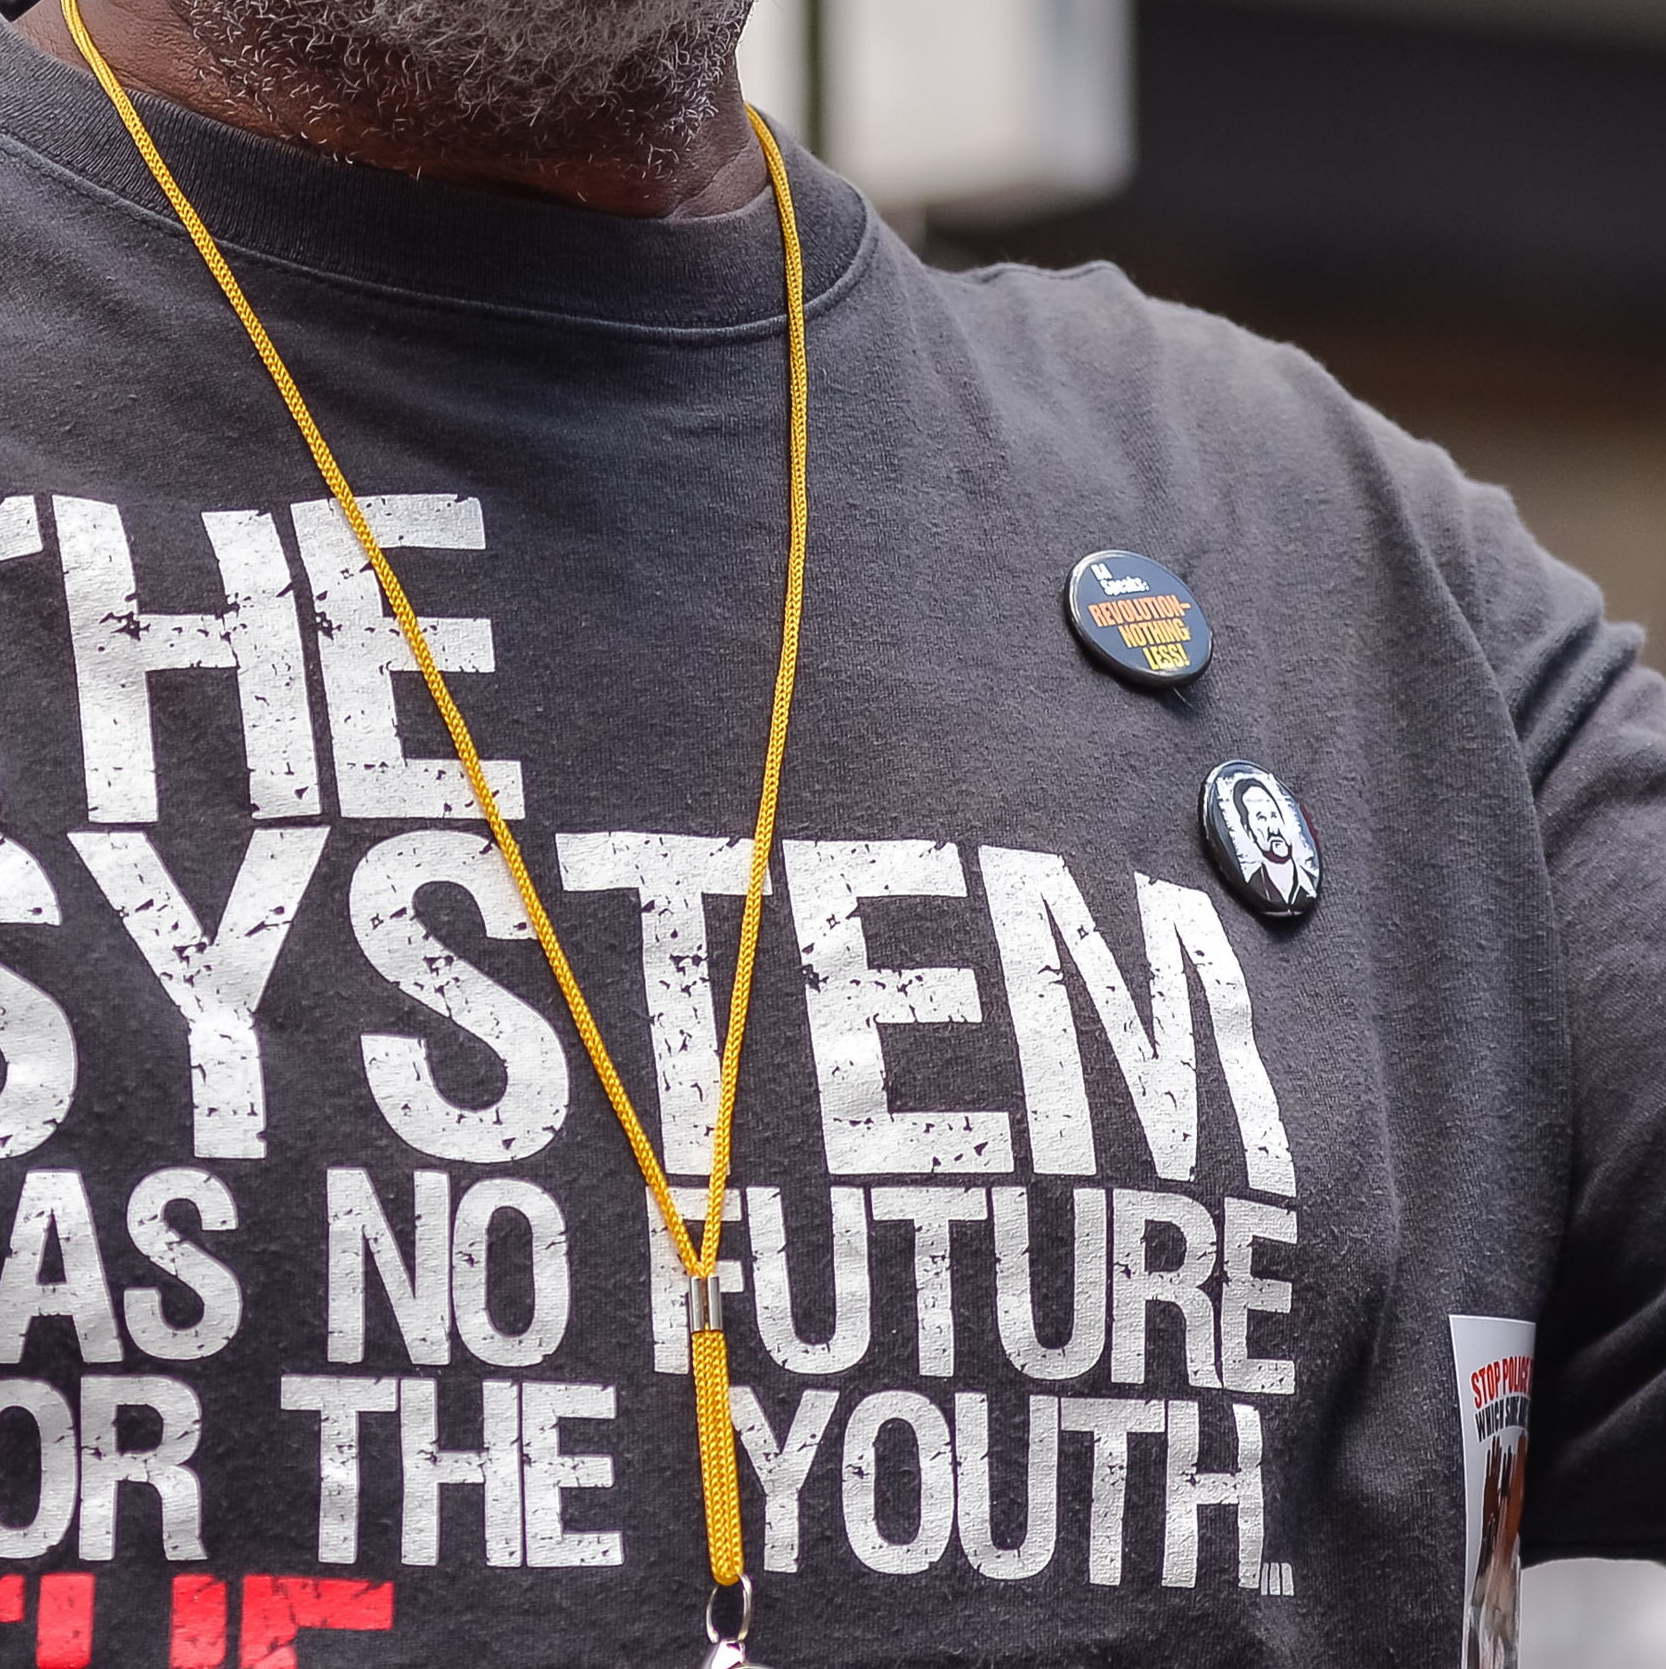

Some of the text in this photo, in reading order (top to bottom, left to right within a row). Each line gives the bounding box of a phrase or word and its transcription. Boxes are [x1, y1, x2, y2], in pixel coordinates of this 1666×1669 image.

[1118, 618, 1191, 649] NOTHING
[1143, 643, 1190, 670] LESS!
[326, 1167, 571, 1367] NO
[646, 1186, 1298, 1394] FUTURE
[1471, 1361, 1500, 1409] STOP
[280, 1374, 625, 1568] THE
